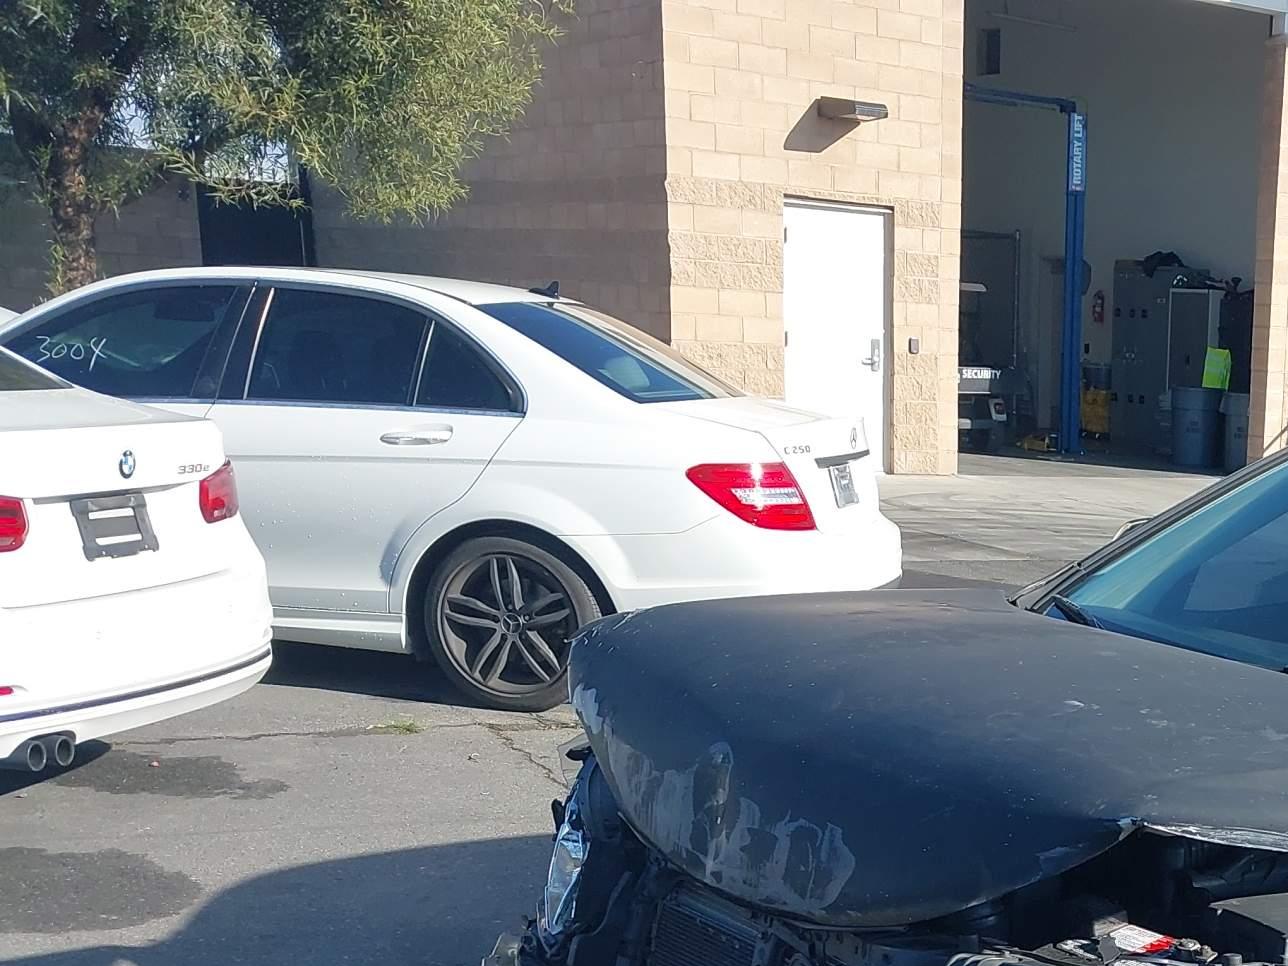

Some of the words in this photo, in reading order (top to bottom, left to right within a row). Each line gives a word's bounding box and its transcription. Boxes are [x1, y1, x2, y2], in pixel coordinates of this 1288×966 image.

[1073, 112, 1084, 138] LIFT
[1072, 140, 1083, 184] ROTARY
[36, 335, 107, 373] 3004
[962, 369, 1002, 380] SECURITY
[792, 445, 811, 454] 250
[177, 463, 211, 475] 330e
